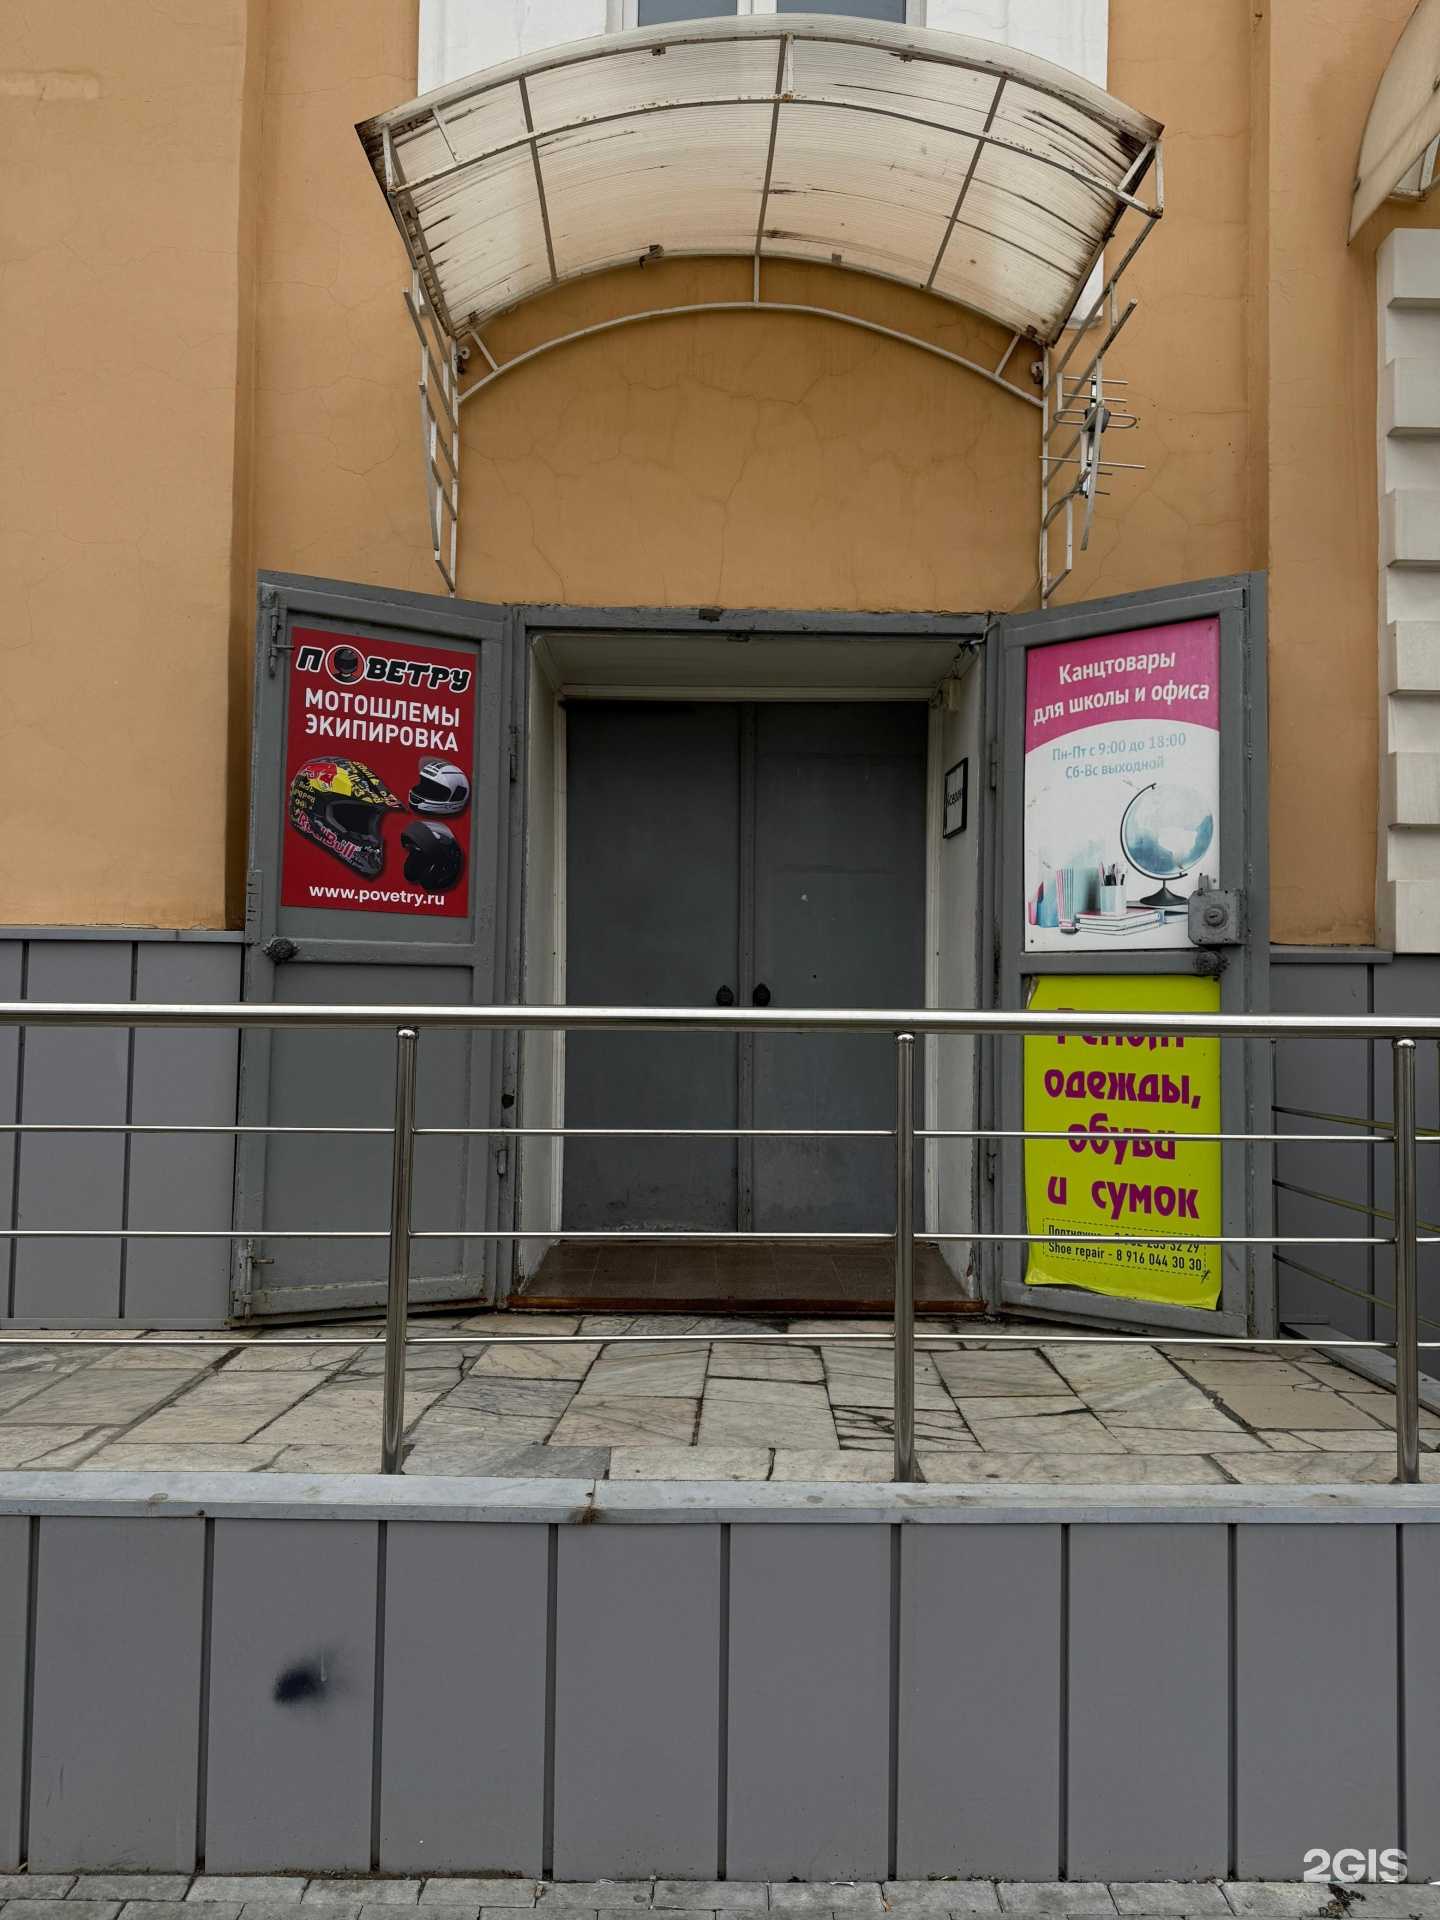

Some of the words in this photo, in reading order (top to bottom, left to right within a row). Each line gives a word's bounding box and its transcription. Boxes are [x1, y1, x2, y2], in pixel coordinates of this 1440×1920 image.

[1058, 652, 1176, 685] Канцтовары
[305, 687, 460, 728] МОТОШЛЕМЫ
[1033, 701, 1065, 726] для
[1069, 688, 1129, 714] школы
[1134, 686, 1146, 703] и
[1151, 680, 1211, 705] офиса
[305, 713, 459, 752] ЭКИПИРОВКА
[1052, 745, 1087, 762] Пн-Пт
[1089, 744, 1096, 757] с
[1098, 739, 1126, 756] 9:00
[1129, 739, 1145, 753] до
[1149, 732, 1187, 750] 18:00
[1065, 763, 1099, 780] Сб-Вс
[1101, 756, 1165, 776] выходной
[309, 885, 445, 907] www.povetry.ru
[1044, 1068, 1201, 1110] одежды,
[1067, 1112, 1176, 1166] обуви
[1047, 1175, 1068, 1206] и
[1091, 1180, 1201, 1221] сумок
[1048, 1241, 1072, 1255] Shoe
[1075, 1246, 1105, 1260] repair
[1116, 1249, 1123, 1262] 8
[1126, 1250, 1145, 1265] 916
[1149, 1252, 1169, 1267] 044
[1172, 1255, 1185, 1269] 30
[1189, 1257, 1202, 1271] 30
